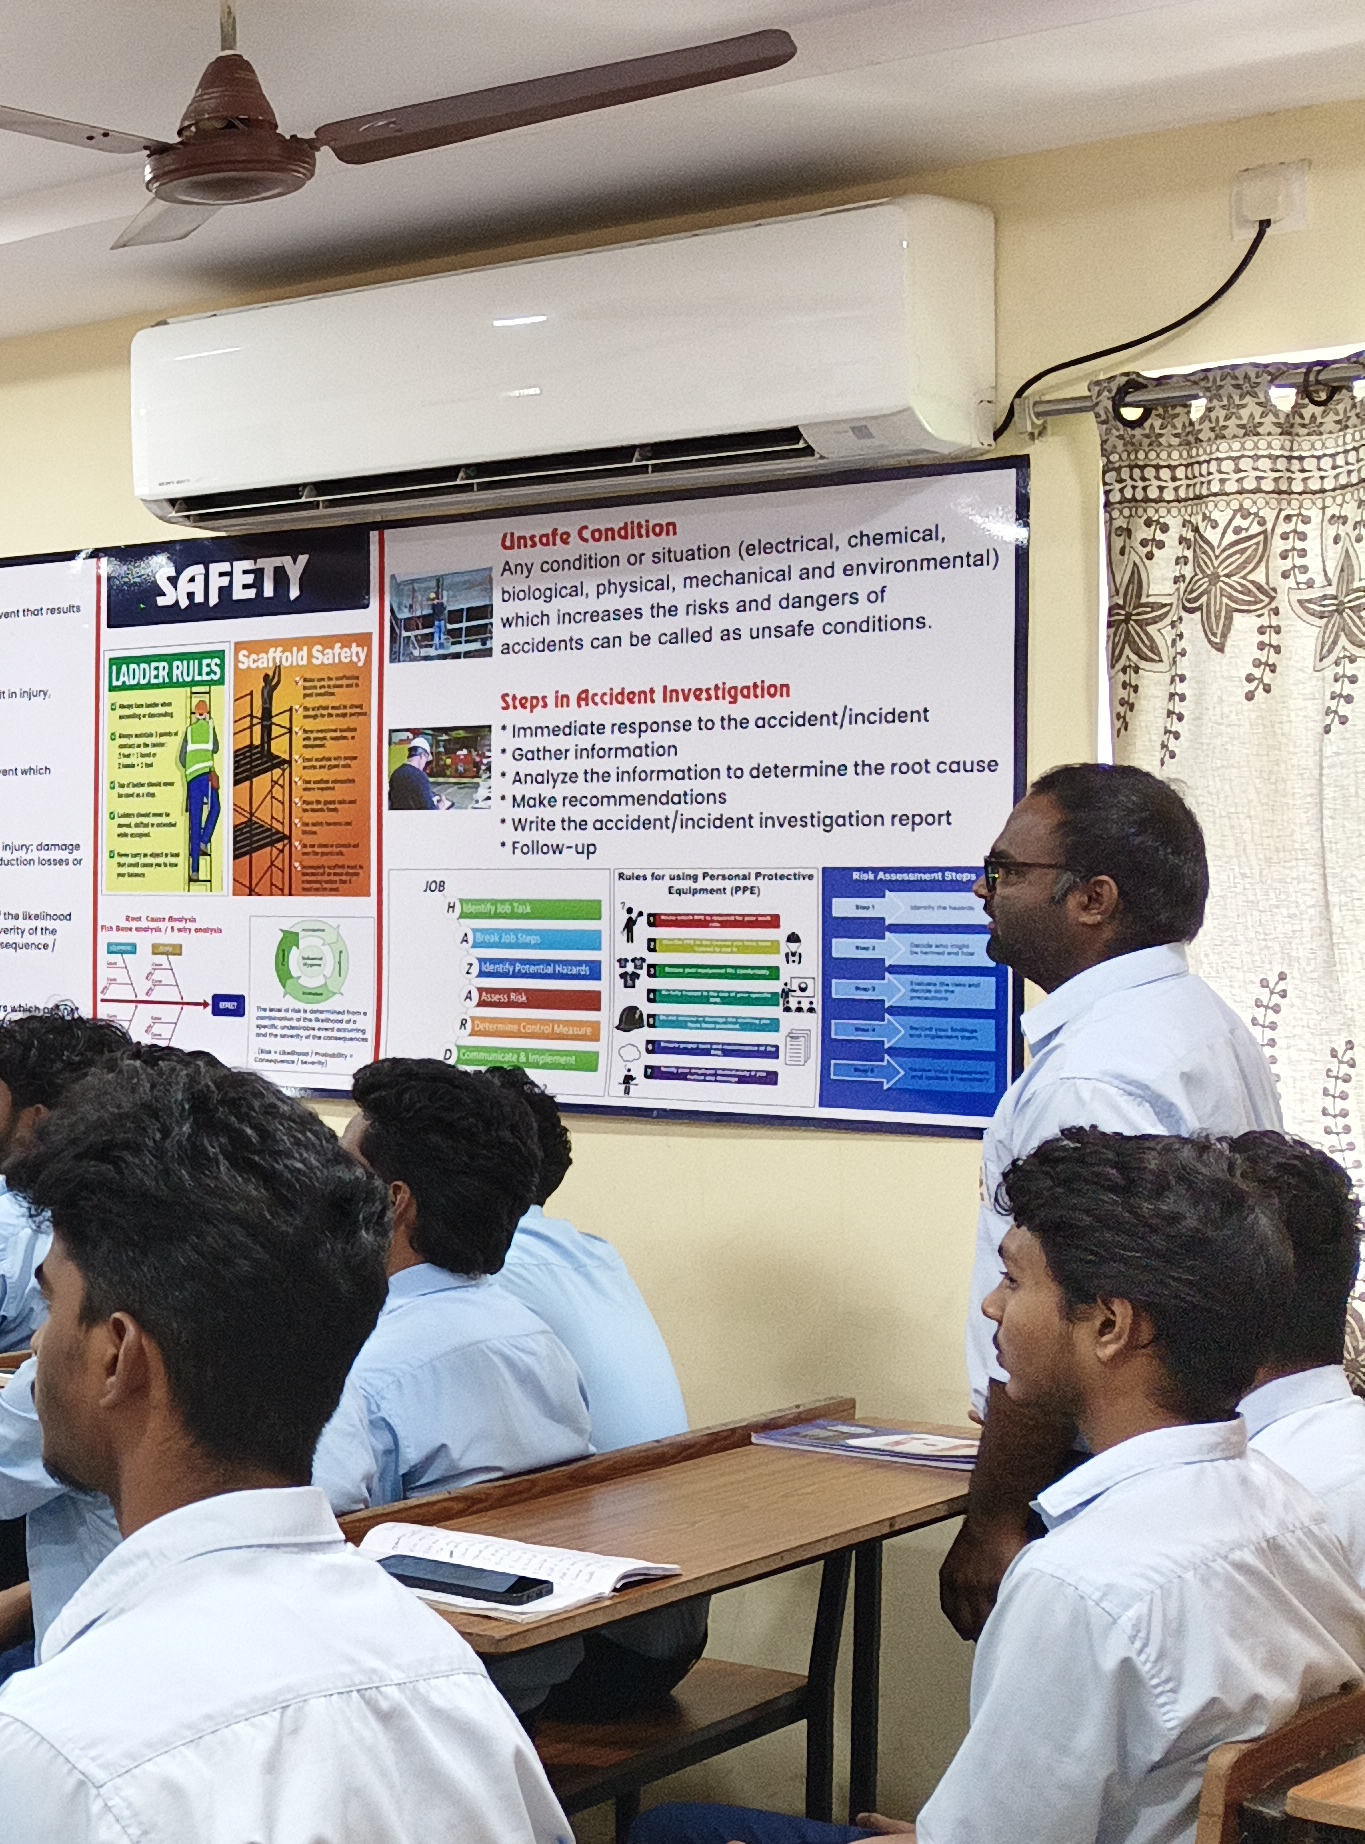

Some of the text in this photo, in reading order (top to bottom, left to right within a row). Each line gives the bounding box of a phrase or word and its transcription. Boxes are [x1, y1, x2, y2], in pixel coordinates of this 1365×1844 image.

[500, 519, 677, 550] Unsafe Condition
[500, 523, 945, 578] Any condition or situation (electrical, chemical,
[156, 554, 309, 609] SAFETY
[501, 548, 998, 603] biological, physical, mechanical and environmental)
[22, 606, 43, 617] that
[45, 603, 80, 615] results
[500, 585, 886, 628] which increases the risks and dangers of
[500, 614, 931, 654] accidents can be called as unsafe conditions.
[237, 642, 367, 669] Scaffold Safety
[111, 657, 220, 686] LADDER RULES
[500, 679, 790, 713] Steps in Accident Investigation
[512, 706, 929, 738] Immediate response to the accident/incident
[511, 740, 677, 761] Gather information
[511, 758, 998, 787] Analyze the information to determine the root cause
[512, 788, 726, 808] Make recommendations
[511, 809, 951, 832] Write the accident/incident investigation report
[511, 839, 597, 860] Follow-up
[423, 880, 445, 893] JOB
[617, 871, 814, 883] Rules for using Personal Protective
[852, 870, 976, 883] Risk Assessment Steps
[668, 885, 760, 897] Equipment (PPE)
[3, 911, 19, 920] the
[22, 910, 71, 921] likelihood
[447, 902, 456, 914] H
[460, 933, 469, 945] A
[465, 963, 473, 975] Z
[464, 990, 473, 1002] A
[459, 1018, 468, 1030] R
[443, 1049, 453, 1060] D
